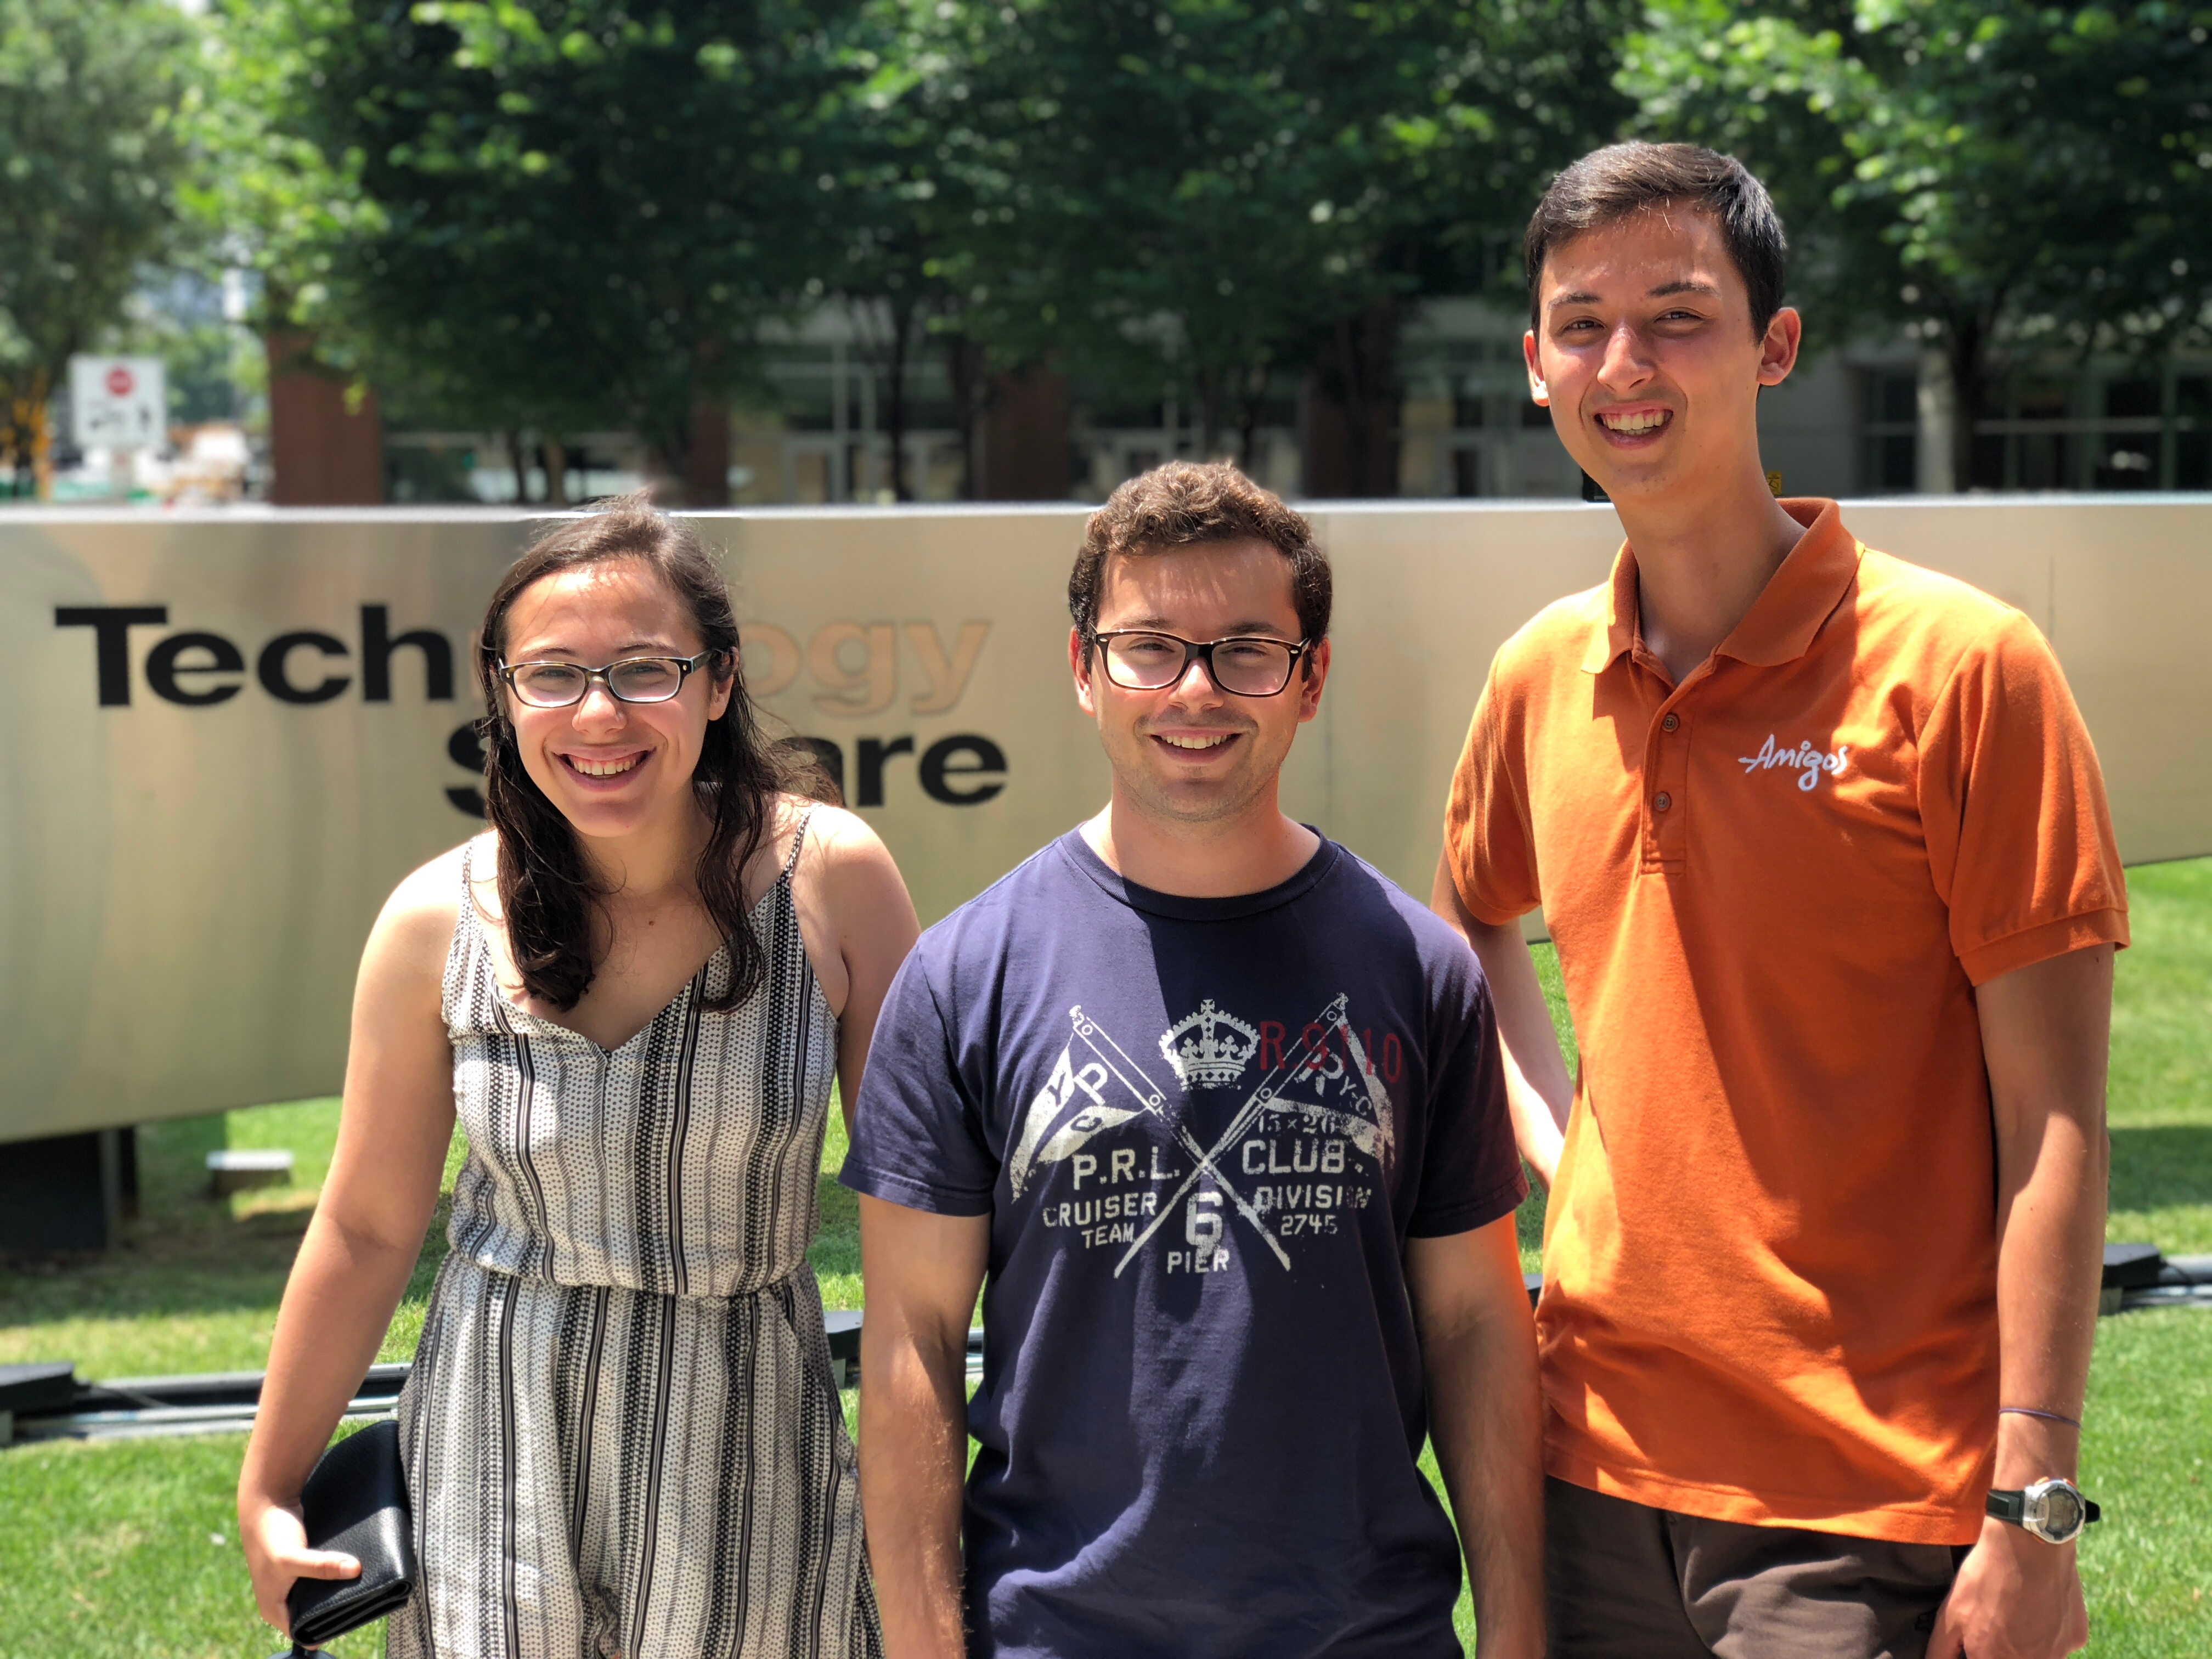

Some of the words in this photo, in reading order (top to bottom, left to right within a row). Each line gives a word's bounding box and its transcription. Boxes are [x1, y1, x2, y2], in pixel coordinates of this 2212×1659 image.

[54, 602, 992, 719] Techogy
[1737, 733, 1848, 792] Amigos
[1073, 1146, 1180, 1190] P.R.L.
[1042, 1191, 1158, 1228] CRUISER
[1280, 1214, 1338, 1236] 2745
[1081, 1222, 1135, 1249] TEAM
[1167, 1249, 1231, 1274] PIER
